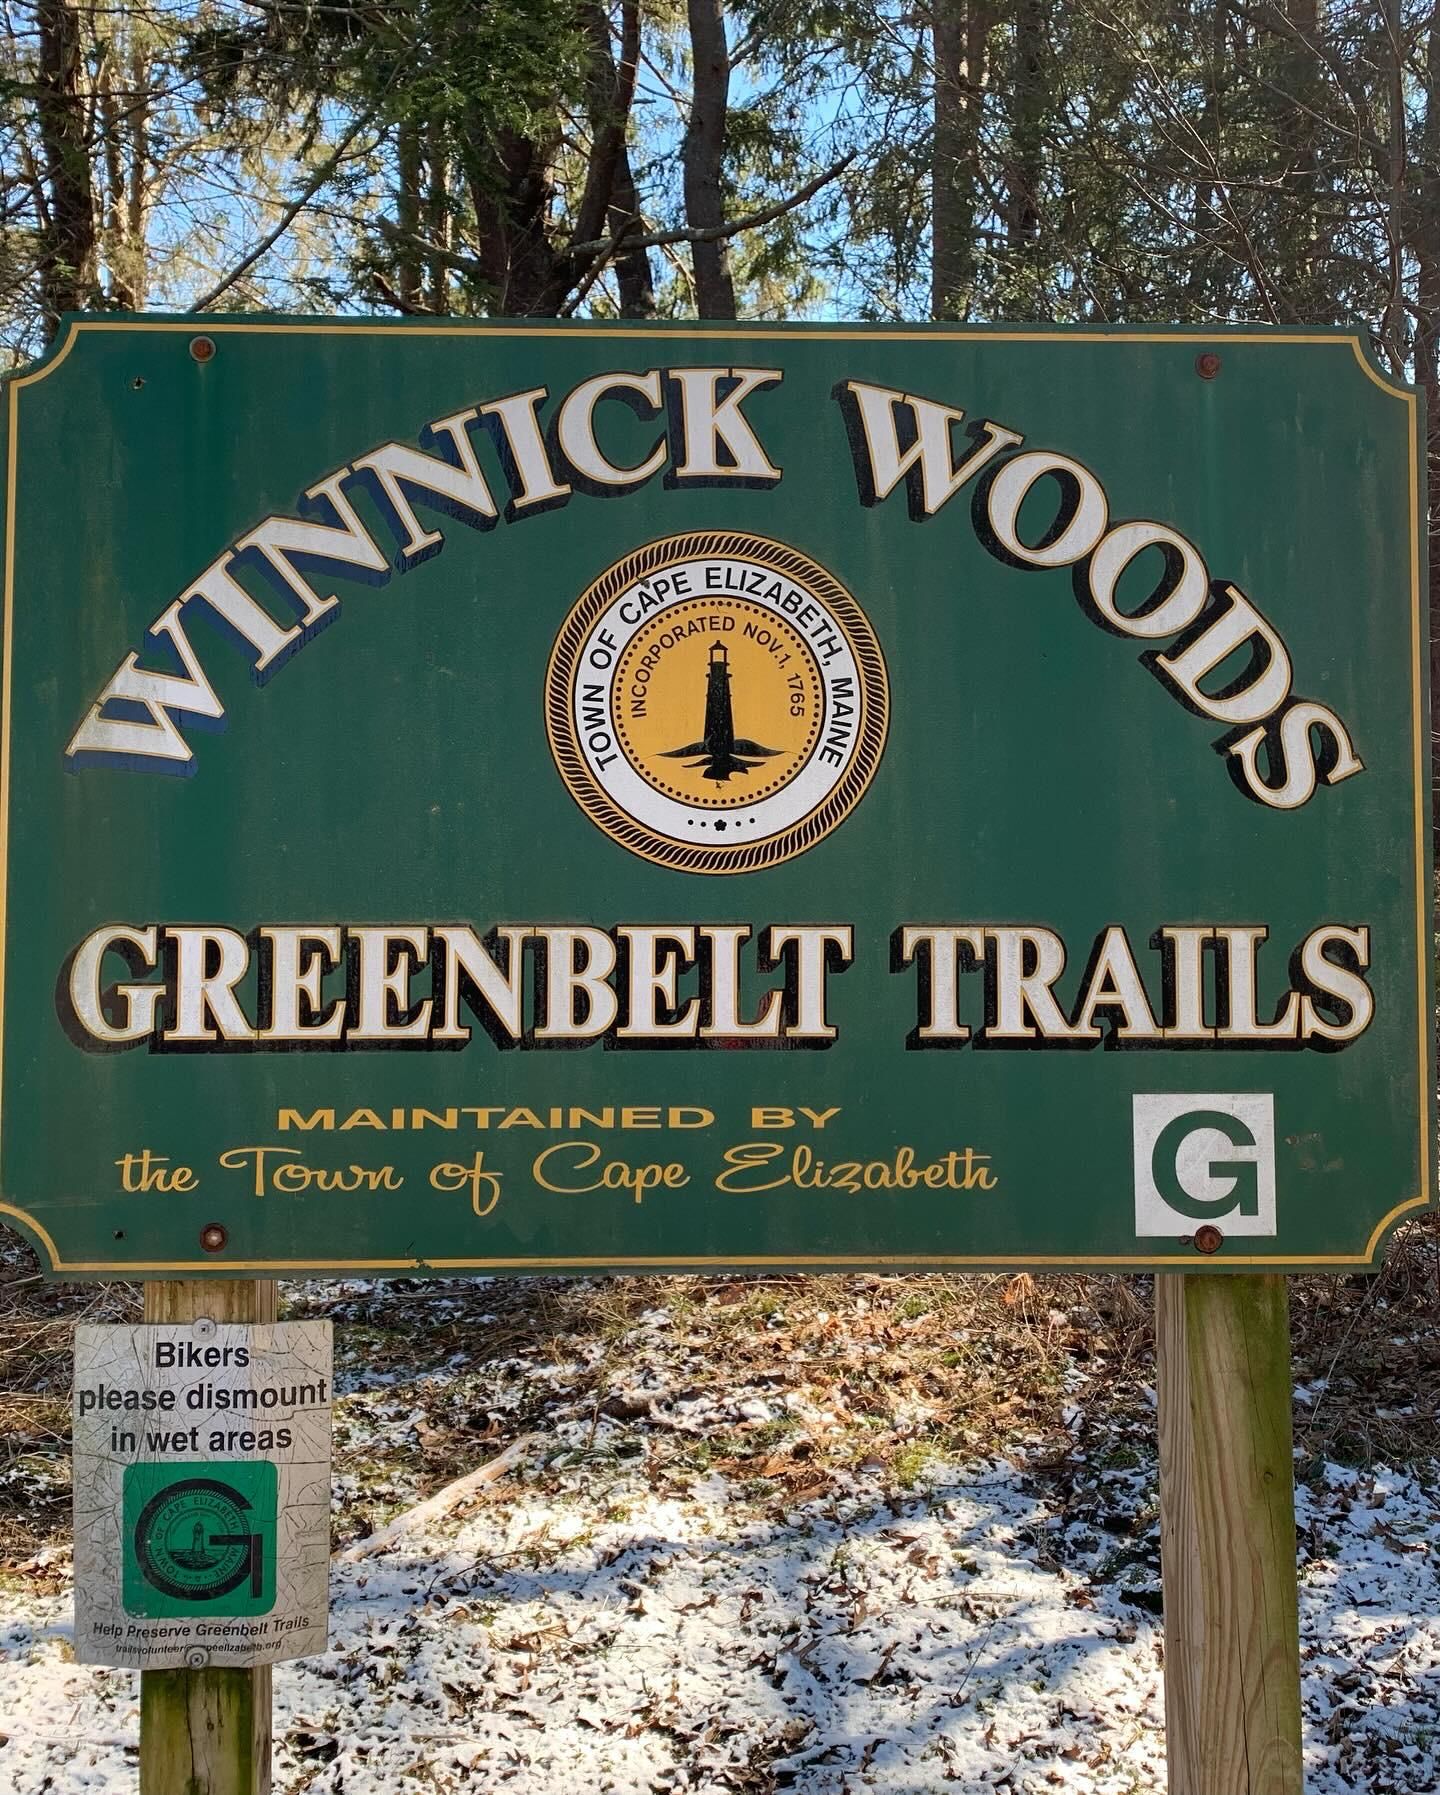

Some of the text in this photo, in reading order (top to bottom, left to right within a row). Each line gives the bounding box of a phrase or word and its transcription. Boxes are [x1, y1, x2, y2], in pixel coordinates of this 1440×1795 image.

[64, 366, 1363, 809] WINNICK WOODS
[583, 566, 854, 773] TOWN OF CAPE ELIZABETH, MAINE
[631, 615, 736, 719] INCORPORATED
[786, 672, 806, 718] 1765
[64, 924, 1375, 1047] GREENBELT TRAILS
[278, 1107, 842, 1130] MAINTAINED BY
[115, 1141, 999, 1217] the Town of Cape Elizabeth
[1150, 1109, 1260, 1219] G
[154, 1341, 251, 1369] Bikers
[79, 1378, 328, 1416] please dismount
[111, 1426, 293, 1452] in wet areas
[163, 1500, 188, 1522] CAPE
[92, 1616, 310, 1639] Help Preserve Greenbelt Trails
[115, 1640, 282, 1655] trailsvolunteer@peelizabeth.org
